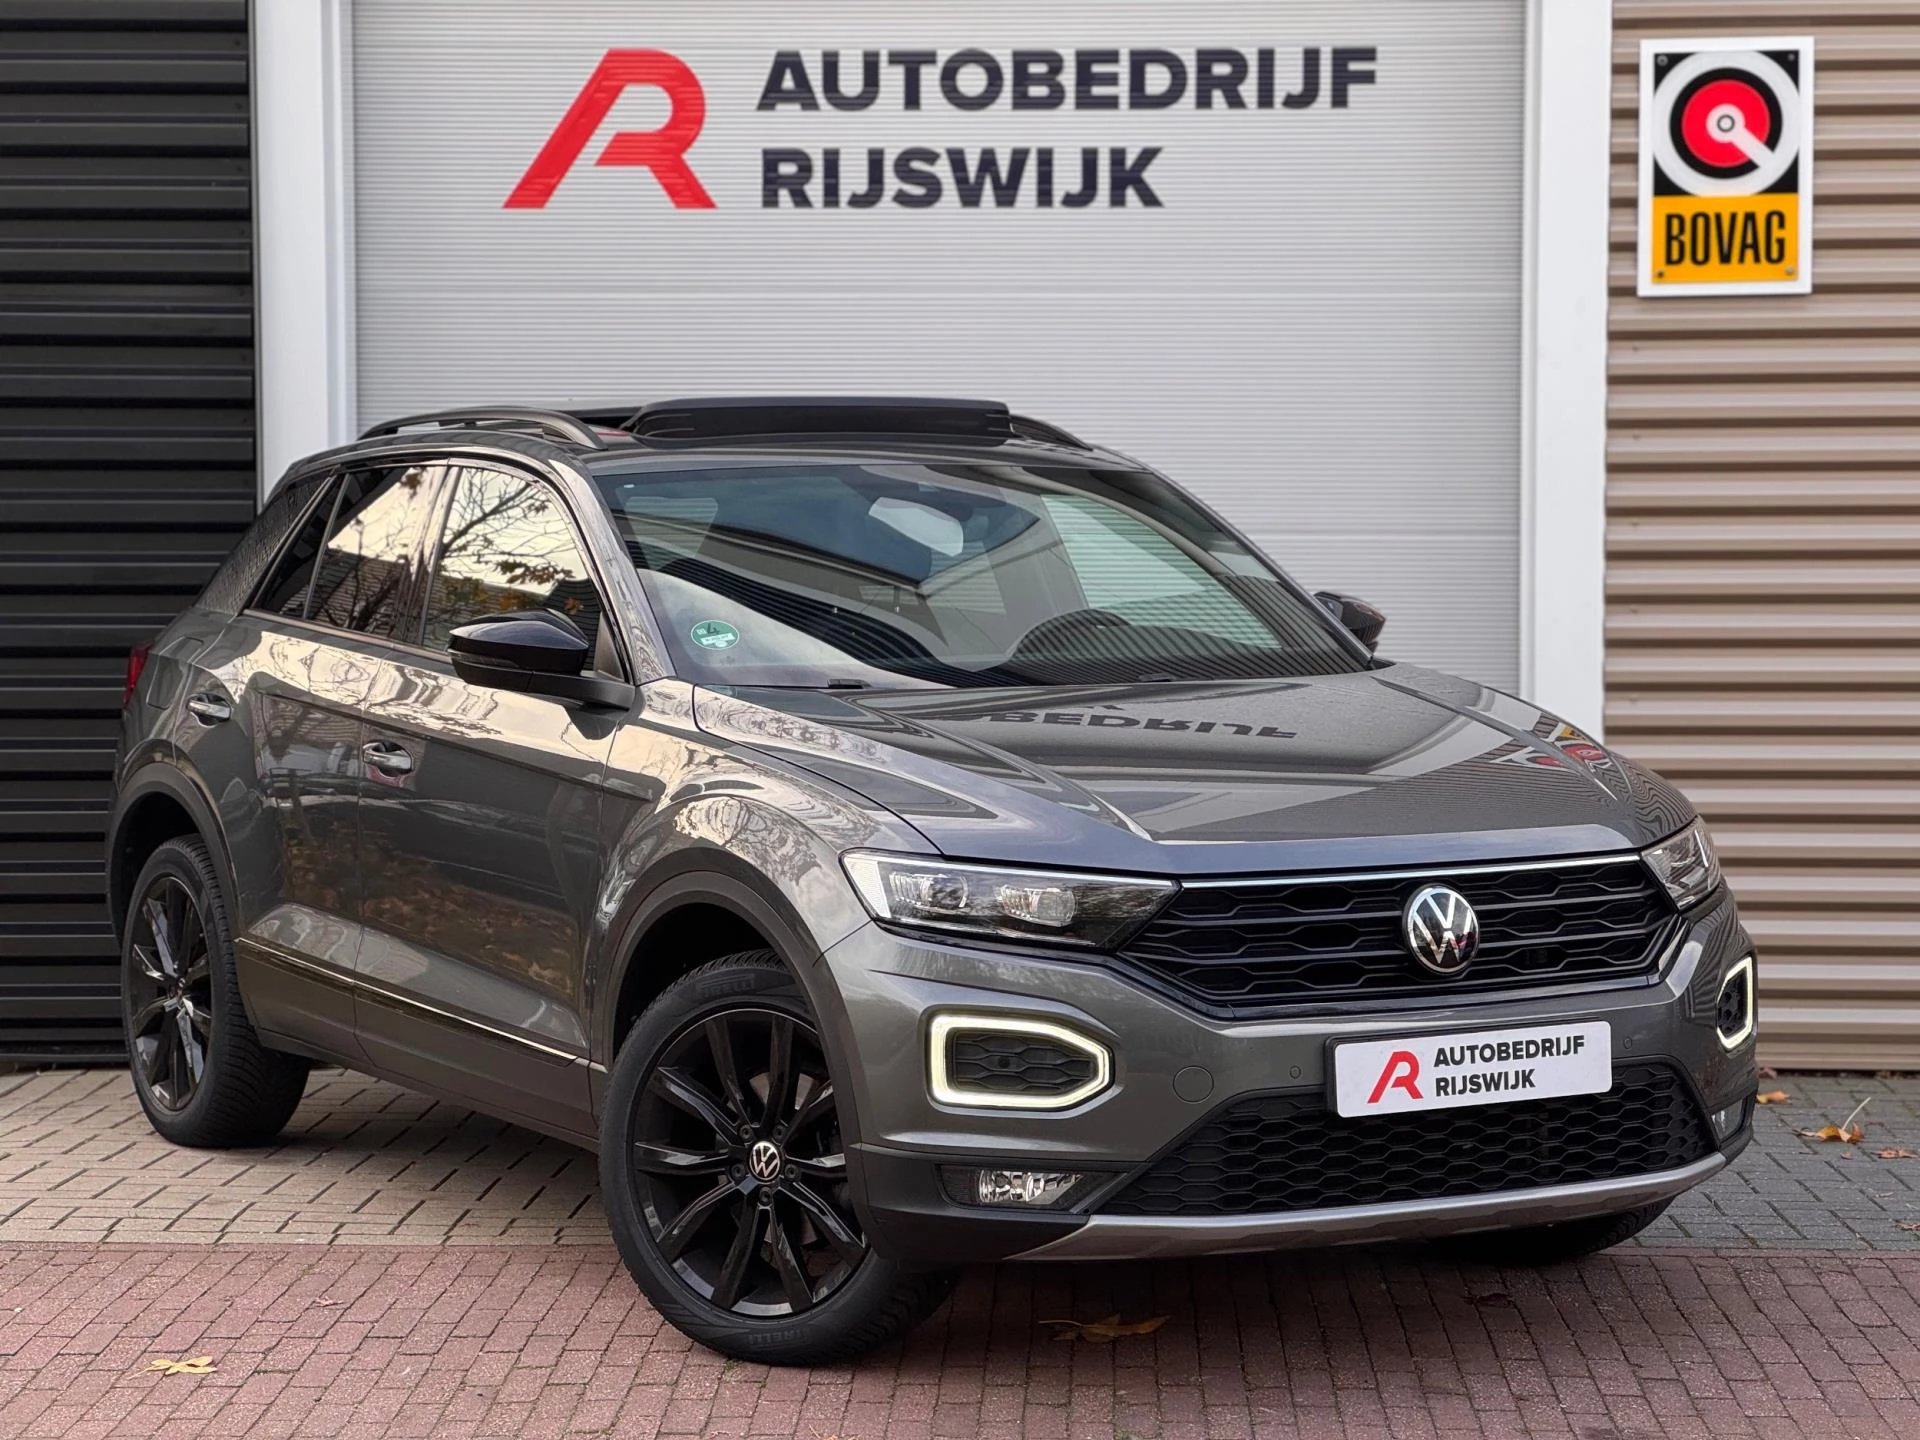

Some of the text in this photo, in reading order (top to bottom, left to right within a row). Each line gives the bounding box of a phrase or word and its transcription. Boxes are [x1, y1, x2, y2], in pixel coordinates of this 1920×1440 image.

[757, 47, 1377, 111] AUTOBEDRIJF
[762, 147, 1163, 209] RIJSWIJK
[1665, 210, 1785, 266] BOVAG
[1433, 1035, 1585, 1067] AUTOBEDRIJF
[1435, 1069, 1535, 1097] RIJSWIJK
